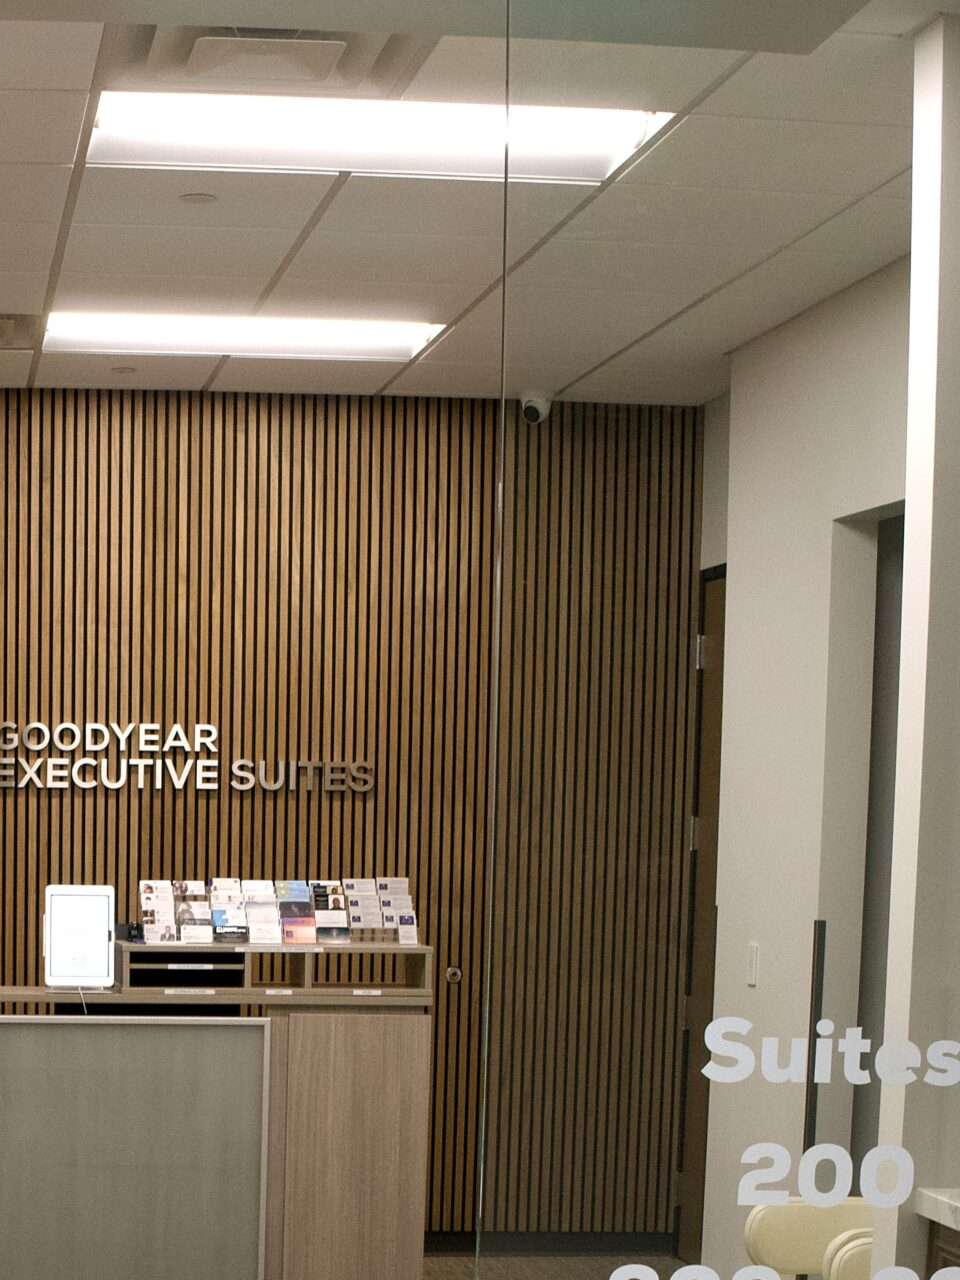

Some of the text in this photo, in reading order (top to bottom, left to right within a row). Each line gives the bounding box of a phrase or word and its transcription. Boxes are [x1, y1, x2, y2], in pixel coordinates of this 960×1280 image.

[230, 760, 375, 792] SUITES
[701, 1017, 960, 1086] Suites
[737, 1143, 915, 1208] 200
